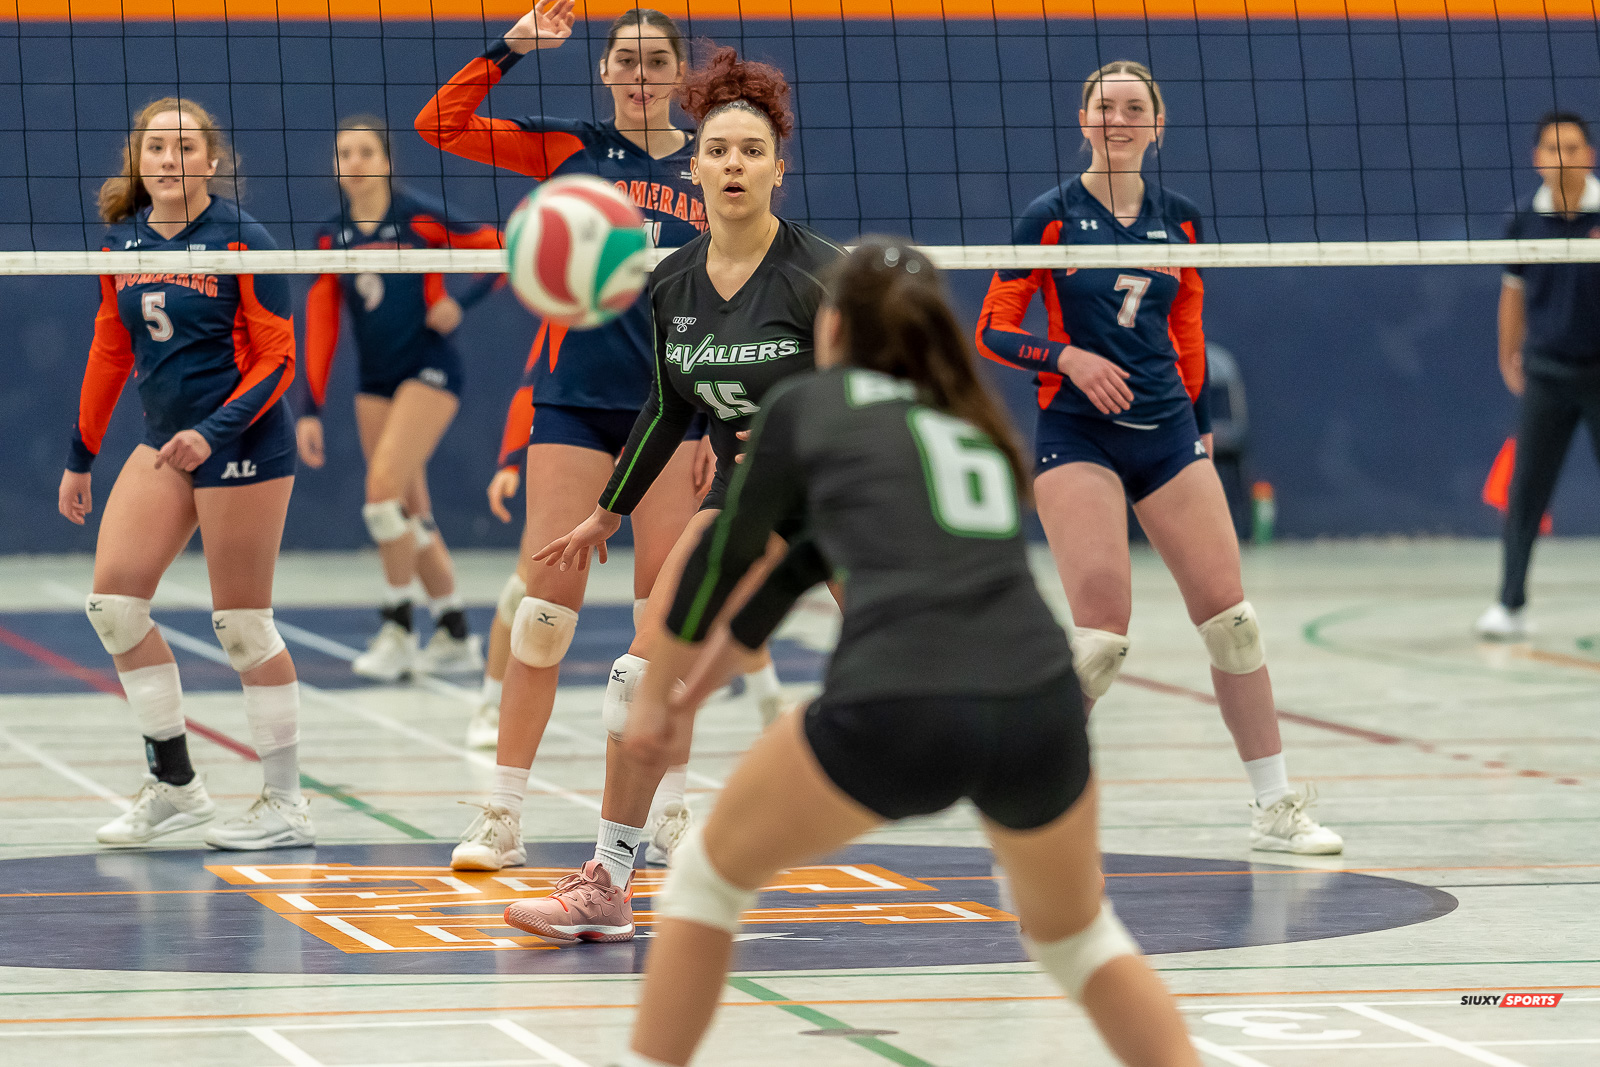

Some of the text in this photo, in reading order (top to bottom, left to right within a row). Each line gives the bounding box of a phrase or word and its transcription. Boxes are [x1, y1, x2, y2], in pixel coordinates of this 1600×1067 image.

[141, 291, 174, 342] 5
[1113, 274, 1152, 328] 7
[665, 333, 799, 374] CAVALIERS
[694, 380, 761, 421] 15
[220, 459, 258, 479] AL
[906, 404, 1021, 539] 6
